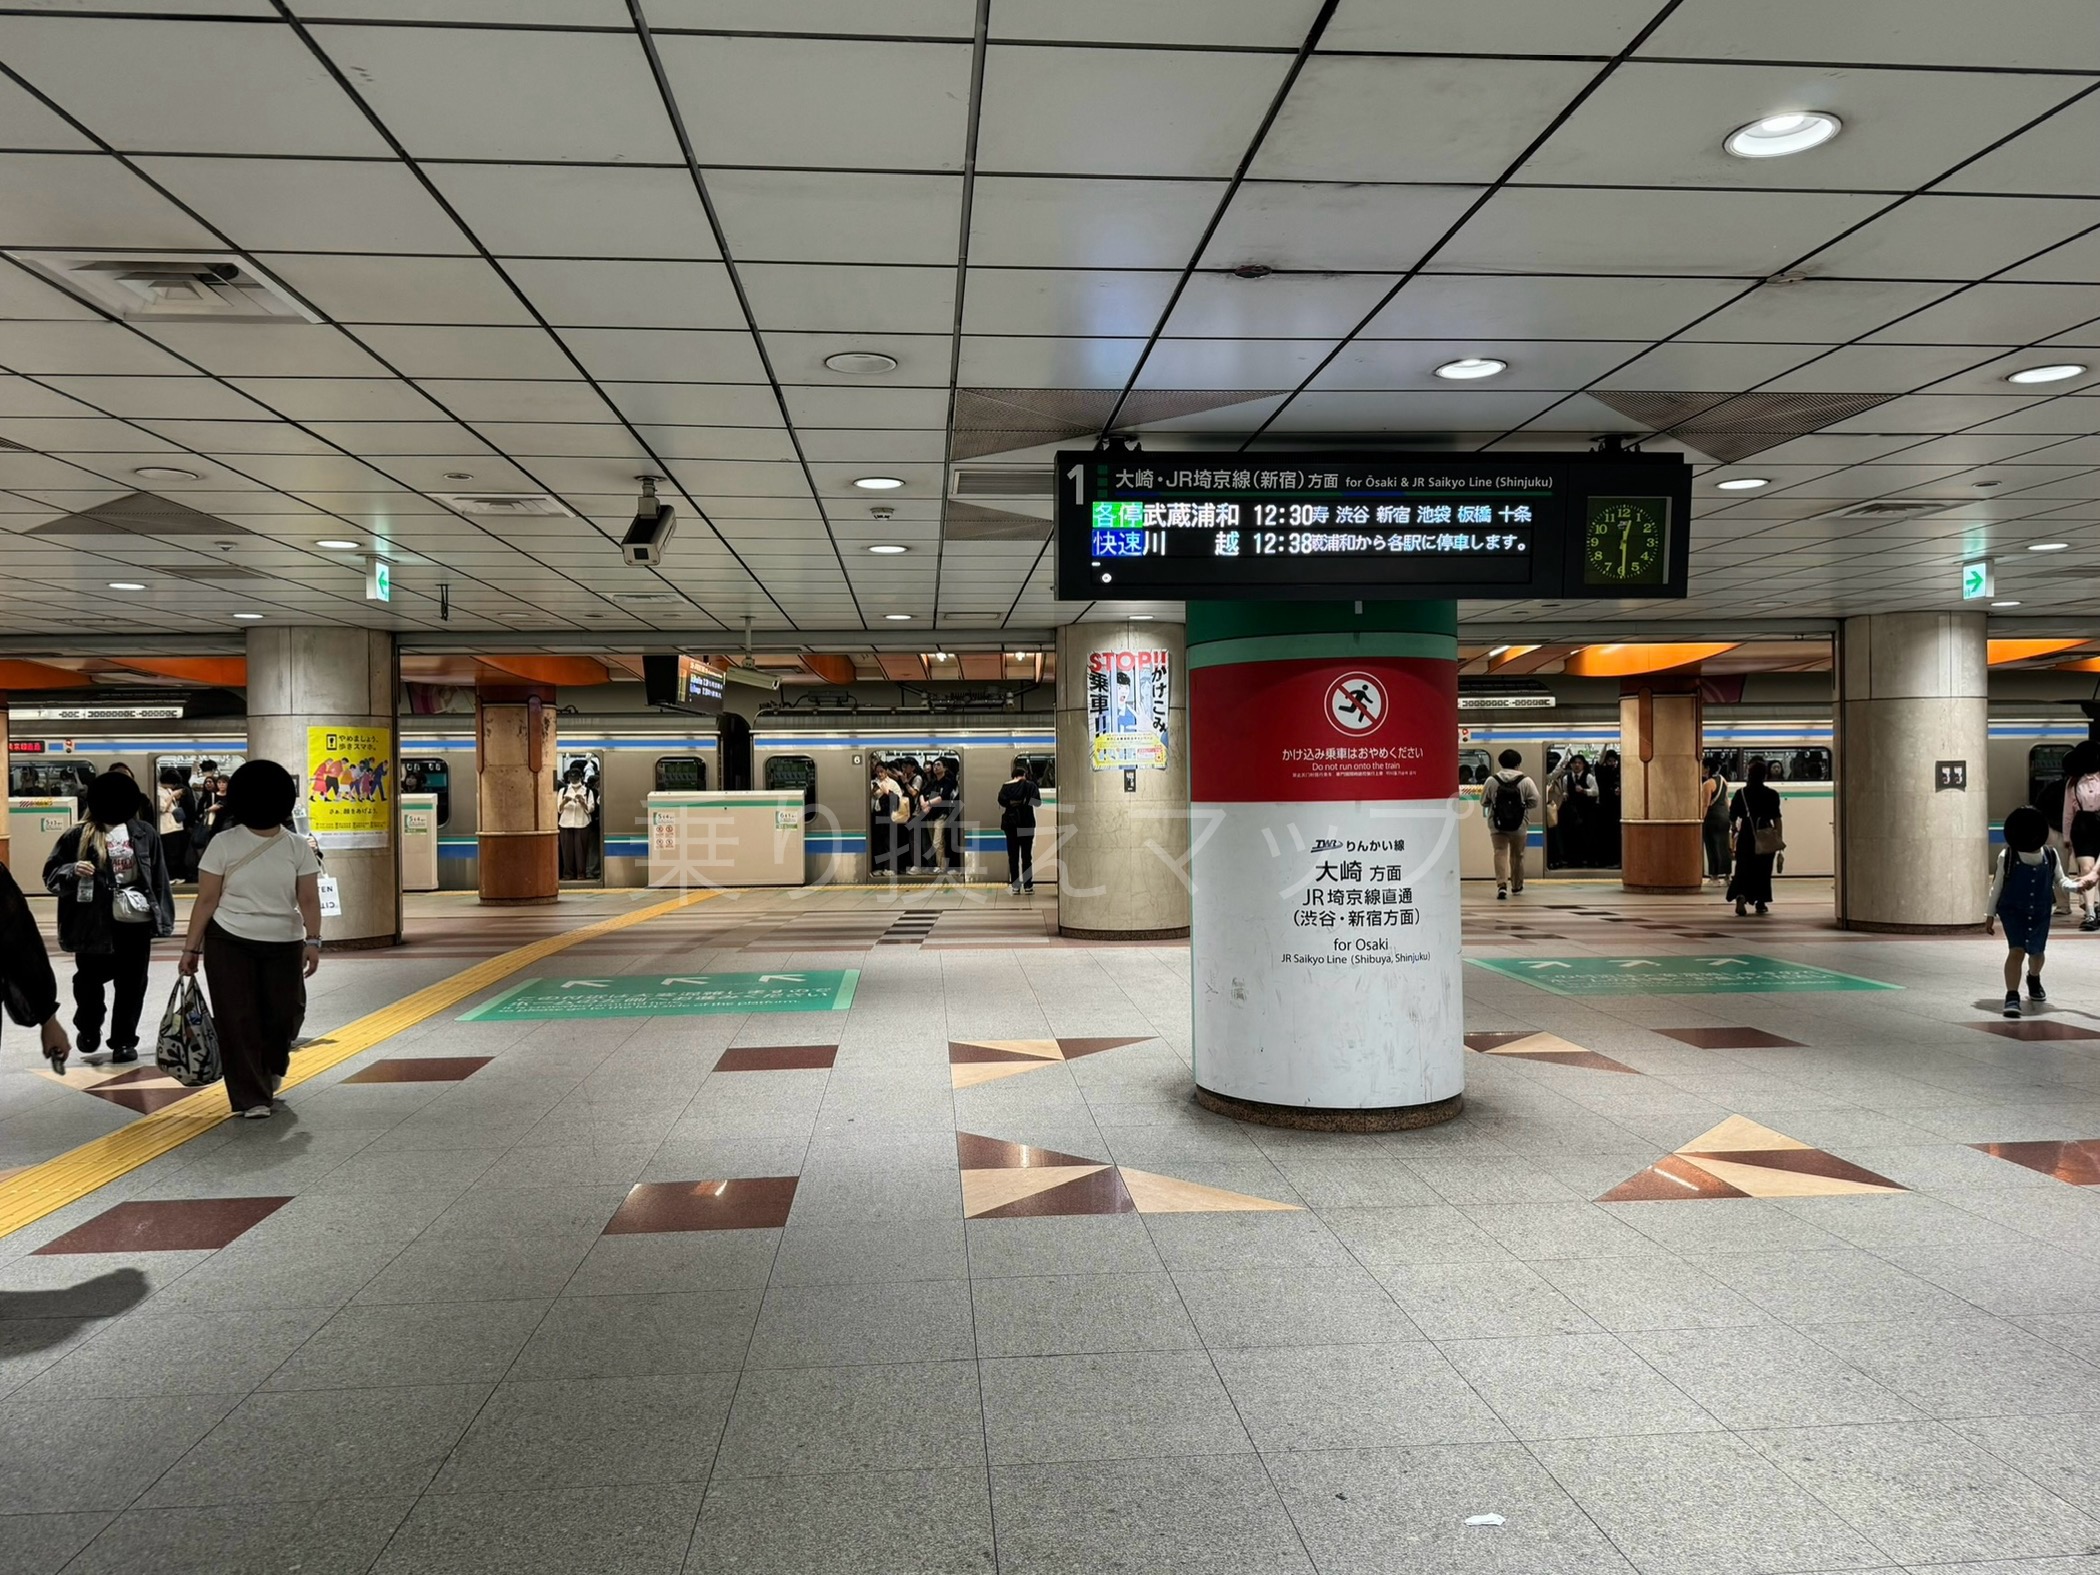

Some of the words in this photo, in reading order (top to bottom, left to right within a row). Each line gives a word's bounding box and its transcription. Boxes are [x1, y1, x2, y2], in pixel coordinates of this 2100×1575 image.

[1067, 464, 1084, 505] 1
[1346, 477, 1362, 488] for
[1365, 475, 1397, 488] Ōsaki
[1401, 477, 1409, 488] &
[1412, 477, 1425, 488] JR
[1428, 477, 1465, 490] Saikyo
[1469, 477, 1492, 488] Line
[1495, 477, 1553, 490] (Shinjuku)
[1253, 504, 1312, 526] 12:30
[1336, 505, 1370, 523] 渋谷
[1376, 505, 1411, 523] 新宿
[1417, 505, 1451, 523] 池袋
[1458, 505, 1492, 523] 板橋
[1498, 505, 1532, 523] 十条
[1604, 513, 1615, 522] 11
[1618, 508, 1631, 518] 12
[1636, 513, 1641, 522] 1
[1595, 524, 1608, 534] 10
[1643, 523, 1652, 533] 2
[1253, 533, 1312, 554] 12:38
[1590, 537, 1599, 547] 9
[1646, 538, 1655, 547] 3
[1594, 551, 1603, 560] 8
[1640, 551, 1649, 560] 4
[1604, 562, 1612, 571] 7
[1631, 562, 1640, 571] 5
[1089, 651, 1167, 672] STOP!!
[1151, 665, 1167, 733] かけこみ
[1282, 747, 1424, 761] かけ込み乗車はおやめください
[854, 755, 861, 764] 6
[1312, 762, 1324, 771] Do
[1325, 762, 1338, 771] not
[1353, 762, 1372, 770] onto
[1373, 762, 1384, 770] the
[1385, 761, 1400, 770] train
[1346, 839, 1405, 852] りんかい線
[1315, 860, 1363, 882] 大崎
[1369, 865, 1402, 882] 方面
[1334, 938, 1351, 951] for
[1355, 938, 1389, 951] Osaki
[1281, 954, 1292, 963] JR
[1294, 954, 1325, 966] Saikyo
[1327, 954, 1347, 964] Line
[1351, 954, 1394, 966] (Shibuya,
[1395, 952, 1431, 964] Shinjuku)
